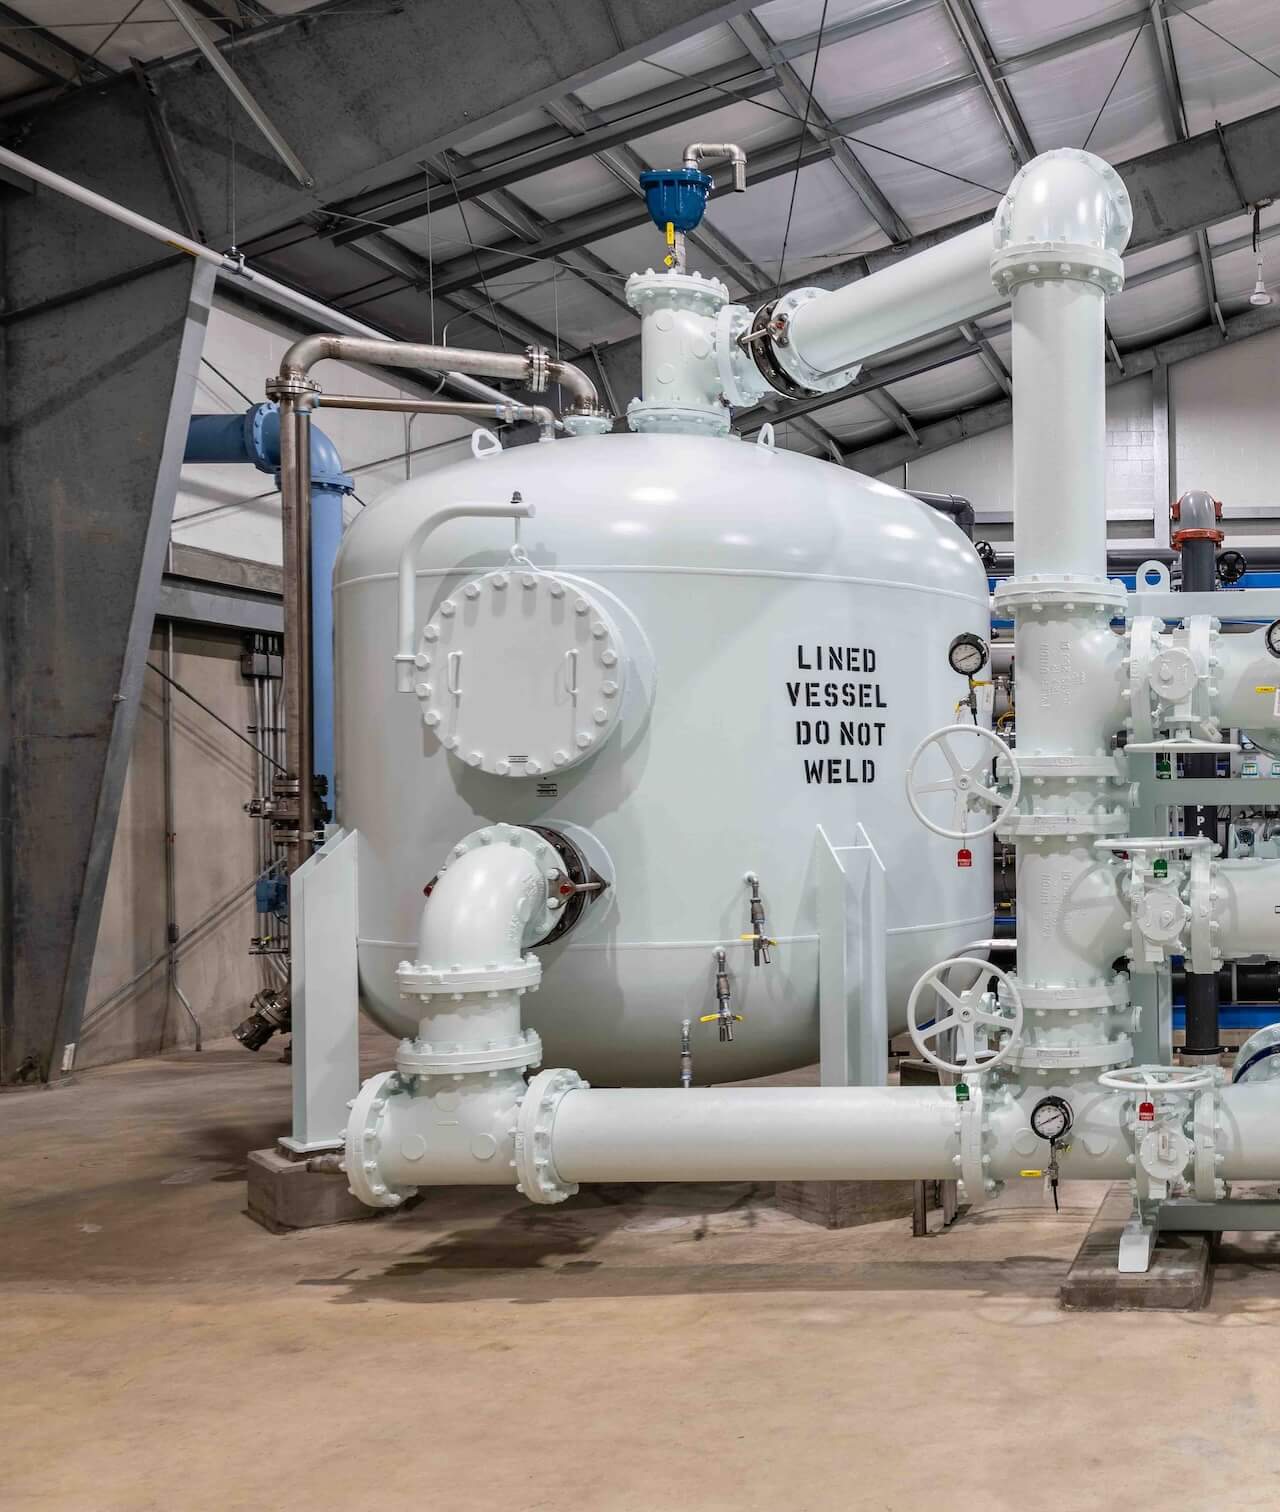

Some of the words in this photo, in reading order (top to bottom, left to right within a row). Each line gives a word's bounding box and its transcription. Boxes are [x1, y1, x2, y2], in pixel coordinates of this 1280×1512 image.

[798, 645, 876, 673] LINED
[786, 682, 887, 708] VESSEL
[796, 720, 830, 745] DO
[840, 721, 886, 746] NOT
[804, 759, 875, 784] WELD
